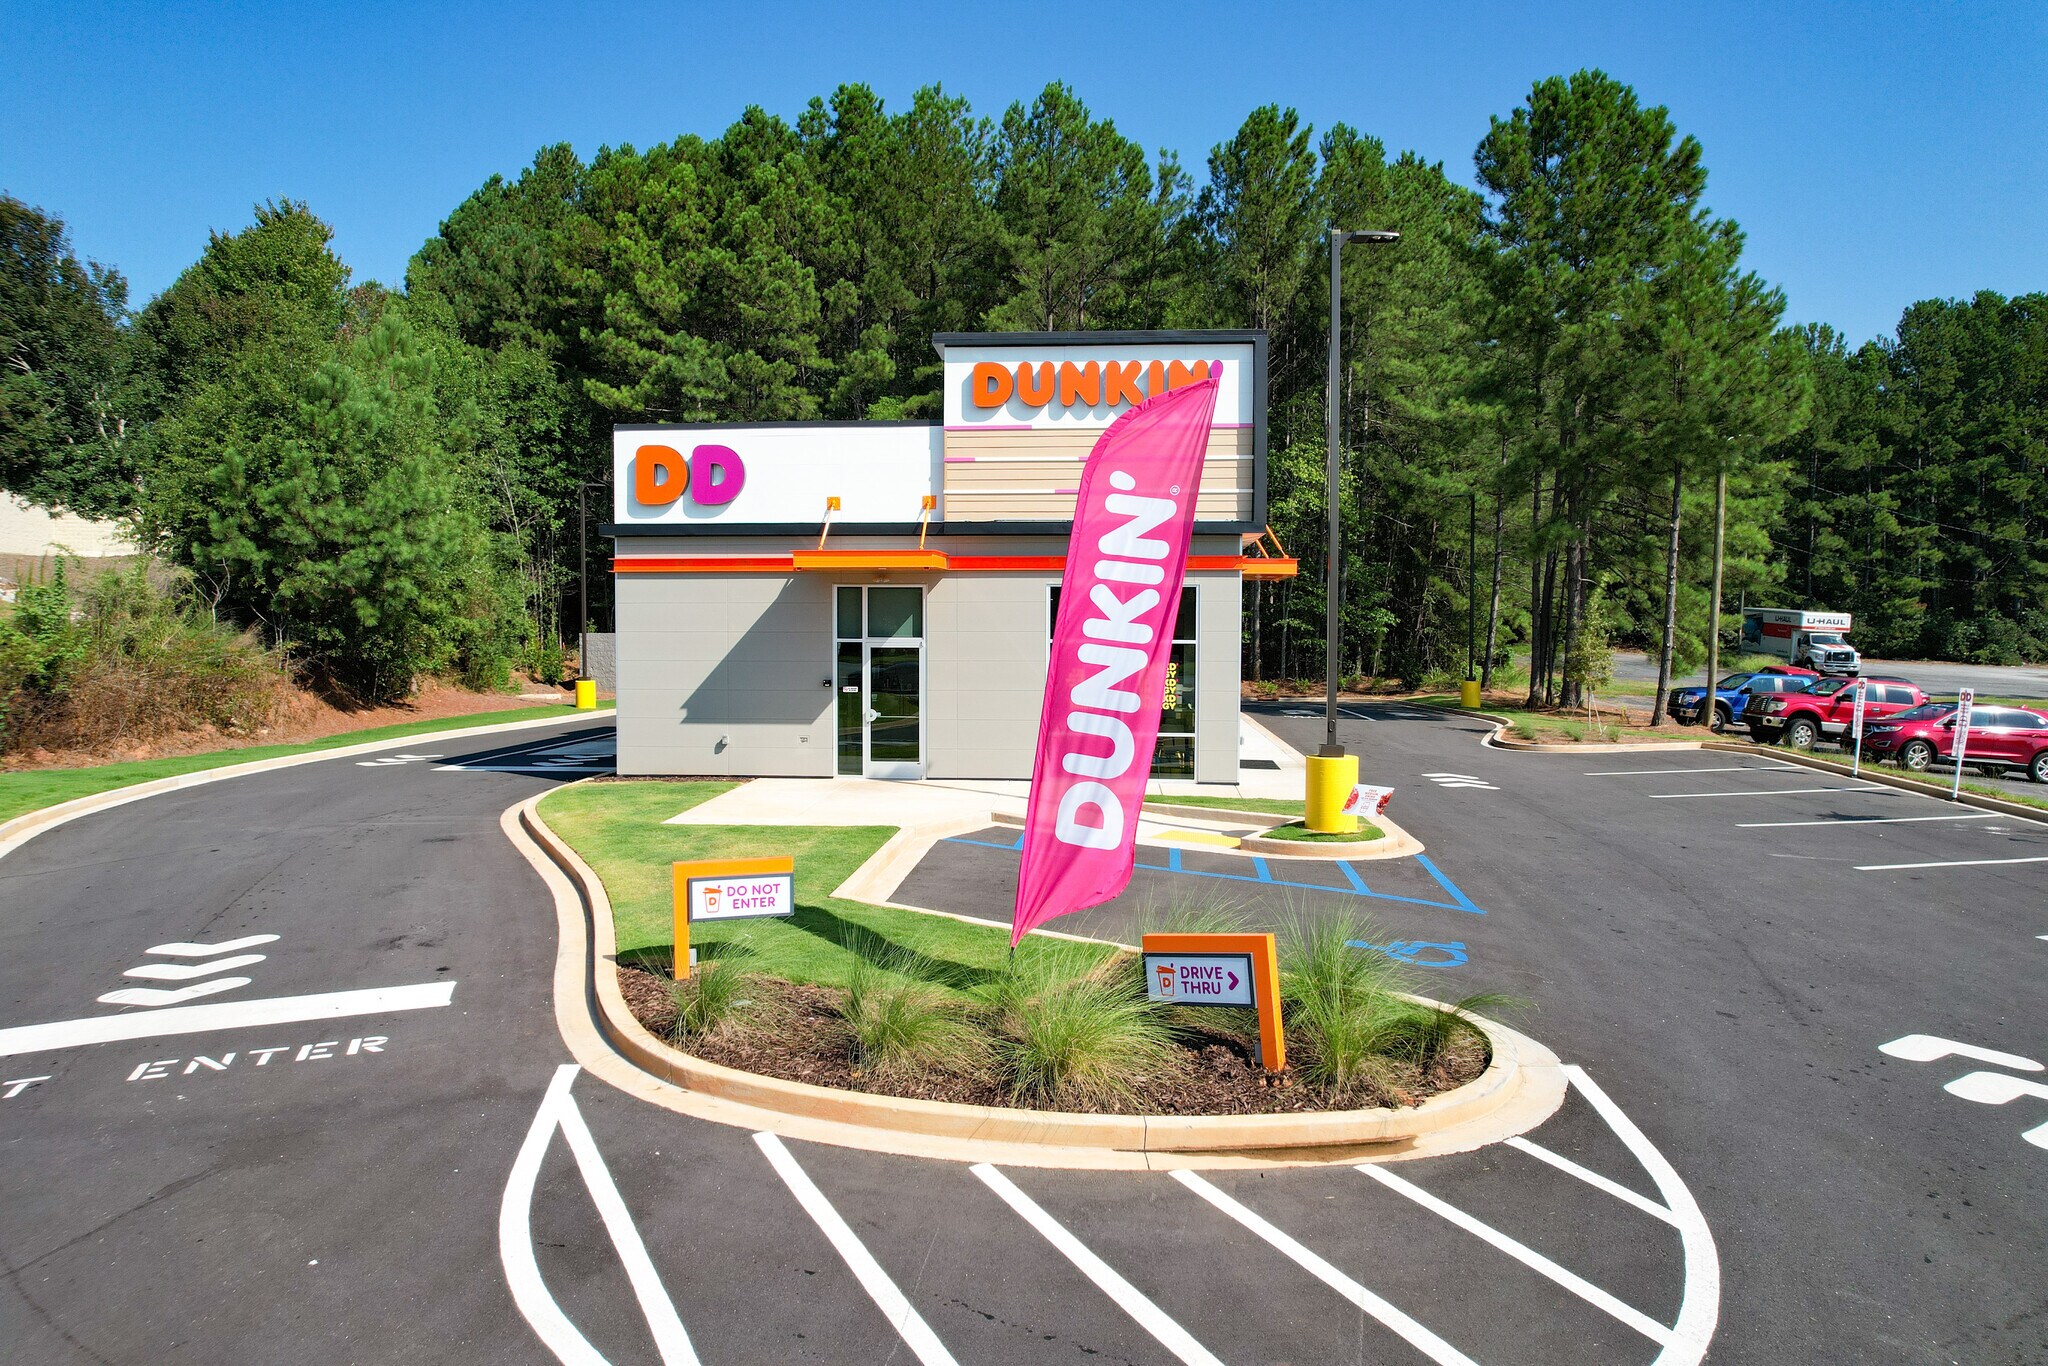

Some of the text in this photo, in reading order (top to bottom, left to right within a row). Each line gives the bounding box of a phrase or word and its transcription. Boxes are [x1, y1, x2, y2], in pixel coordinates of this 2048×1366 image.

[635, 444, 745, 506] DD
[1055, 470, 1178, 851] DUNKIN'
[727, 884, 780, 896] DO NOT
[732, 897, 775, 909] ENTER
[1180, 966, 1223, 979] DRIVE
[1181, 981, 1221, 994] THRU
[126, 1036, 389, 1081] ENTER
